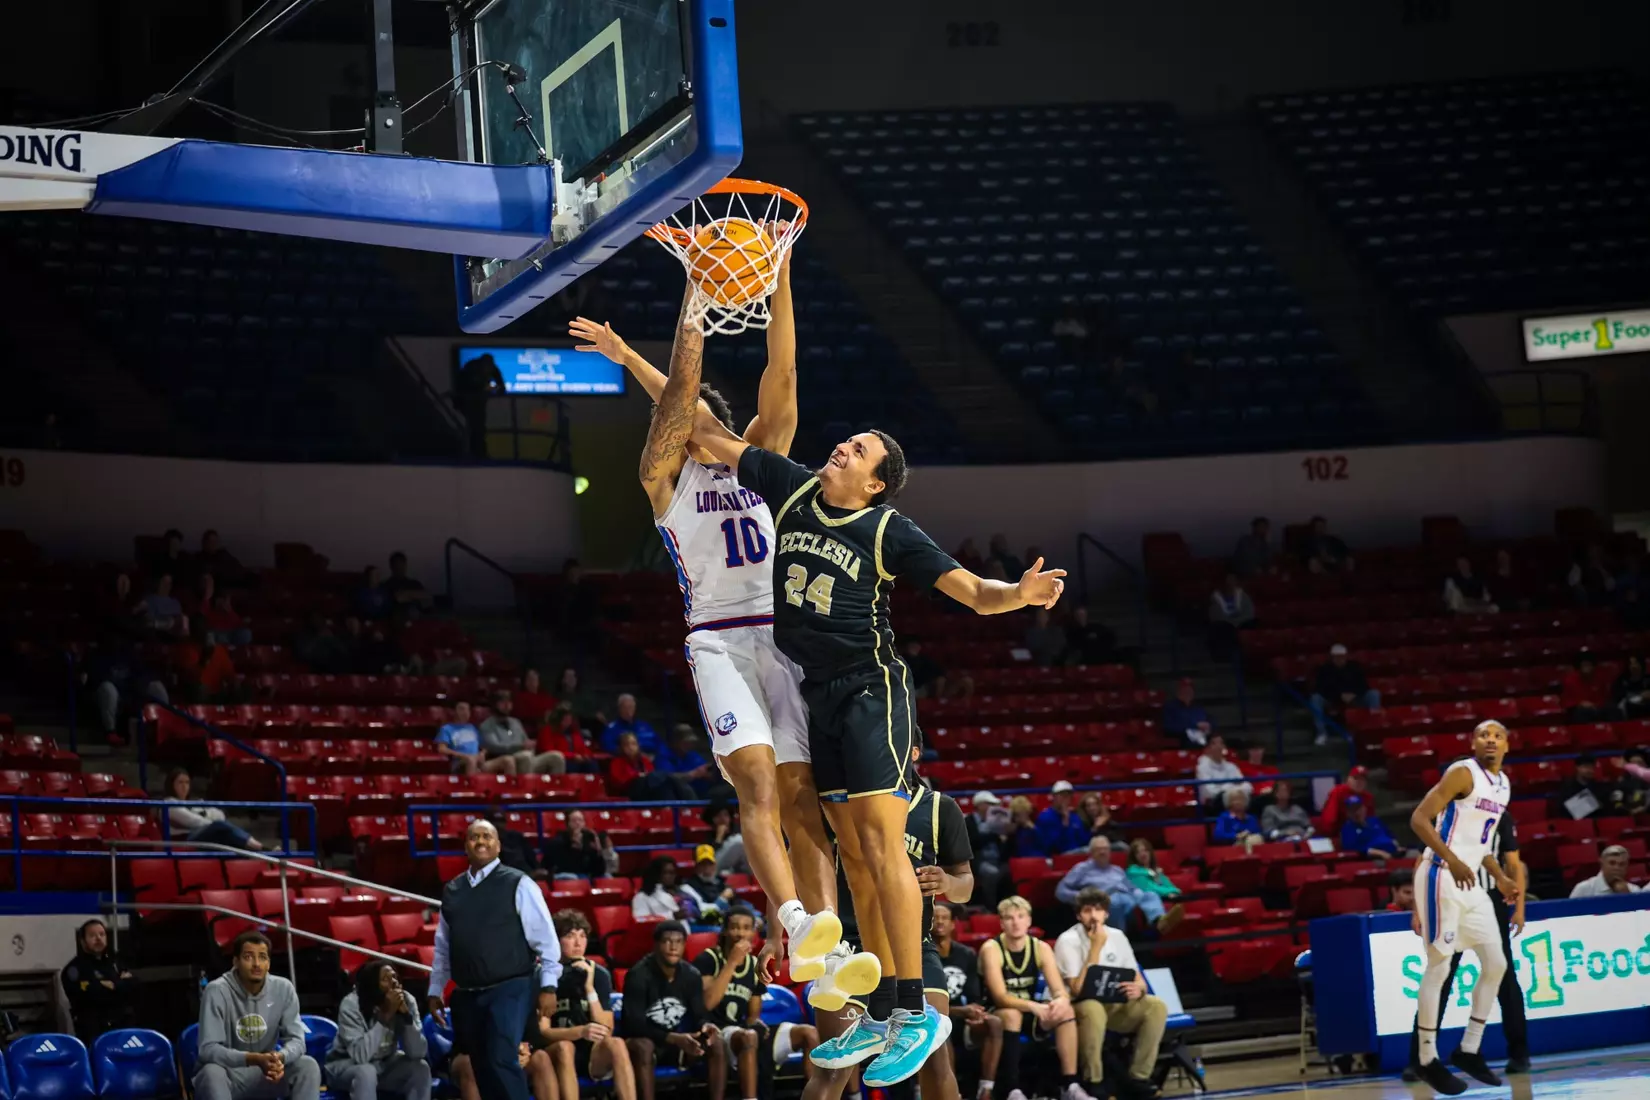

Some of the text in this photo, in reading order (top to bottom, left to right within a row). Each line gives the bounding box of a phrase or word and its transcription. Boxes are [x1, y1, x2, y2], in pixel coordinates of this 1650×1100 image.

[1532, 327, 1591, 350] Super
[1592, 317, 1614, 350] 1
[1302, 456, 1349, 481] 102
[739, 488, 765, 509] TEC
[721, 517, 768, 568] 10
[779, 532, 861, 582] ECCLESIA
[784, 563, 836, 616] 24
[1521, 931, 1565, 1009] 1
